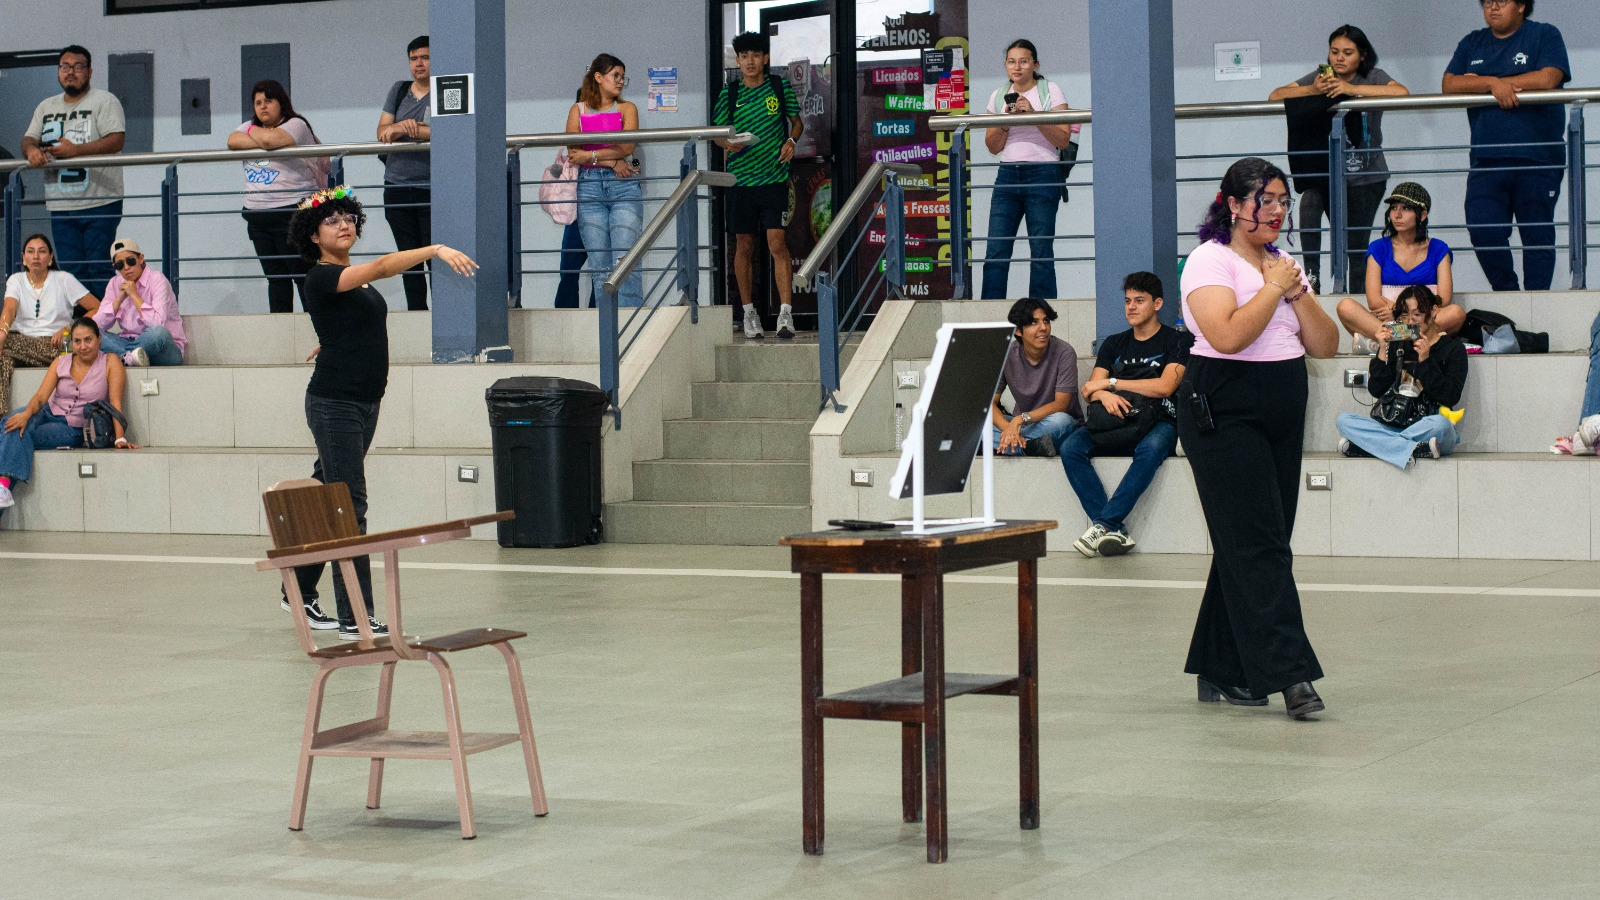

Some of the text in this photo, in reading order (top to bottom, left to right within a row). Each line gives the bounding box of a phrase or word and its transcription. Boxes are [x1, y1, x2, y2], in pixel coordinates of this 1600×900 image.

[876, 70, 919, 82] Licuados
[876, 123, 910, 135] Tortas
[875, 146, 933, 162] Chilaquiles
[911, 202, 950, 214] Frescas
[902, 281, 929, 295] Y MÁS
